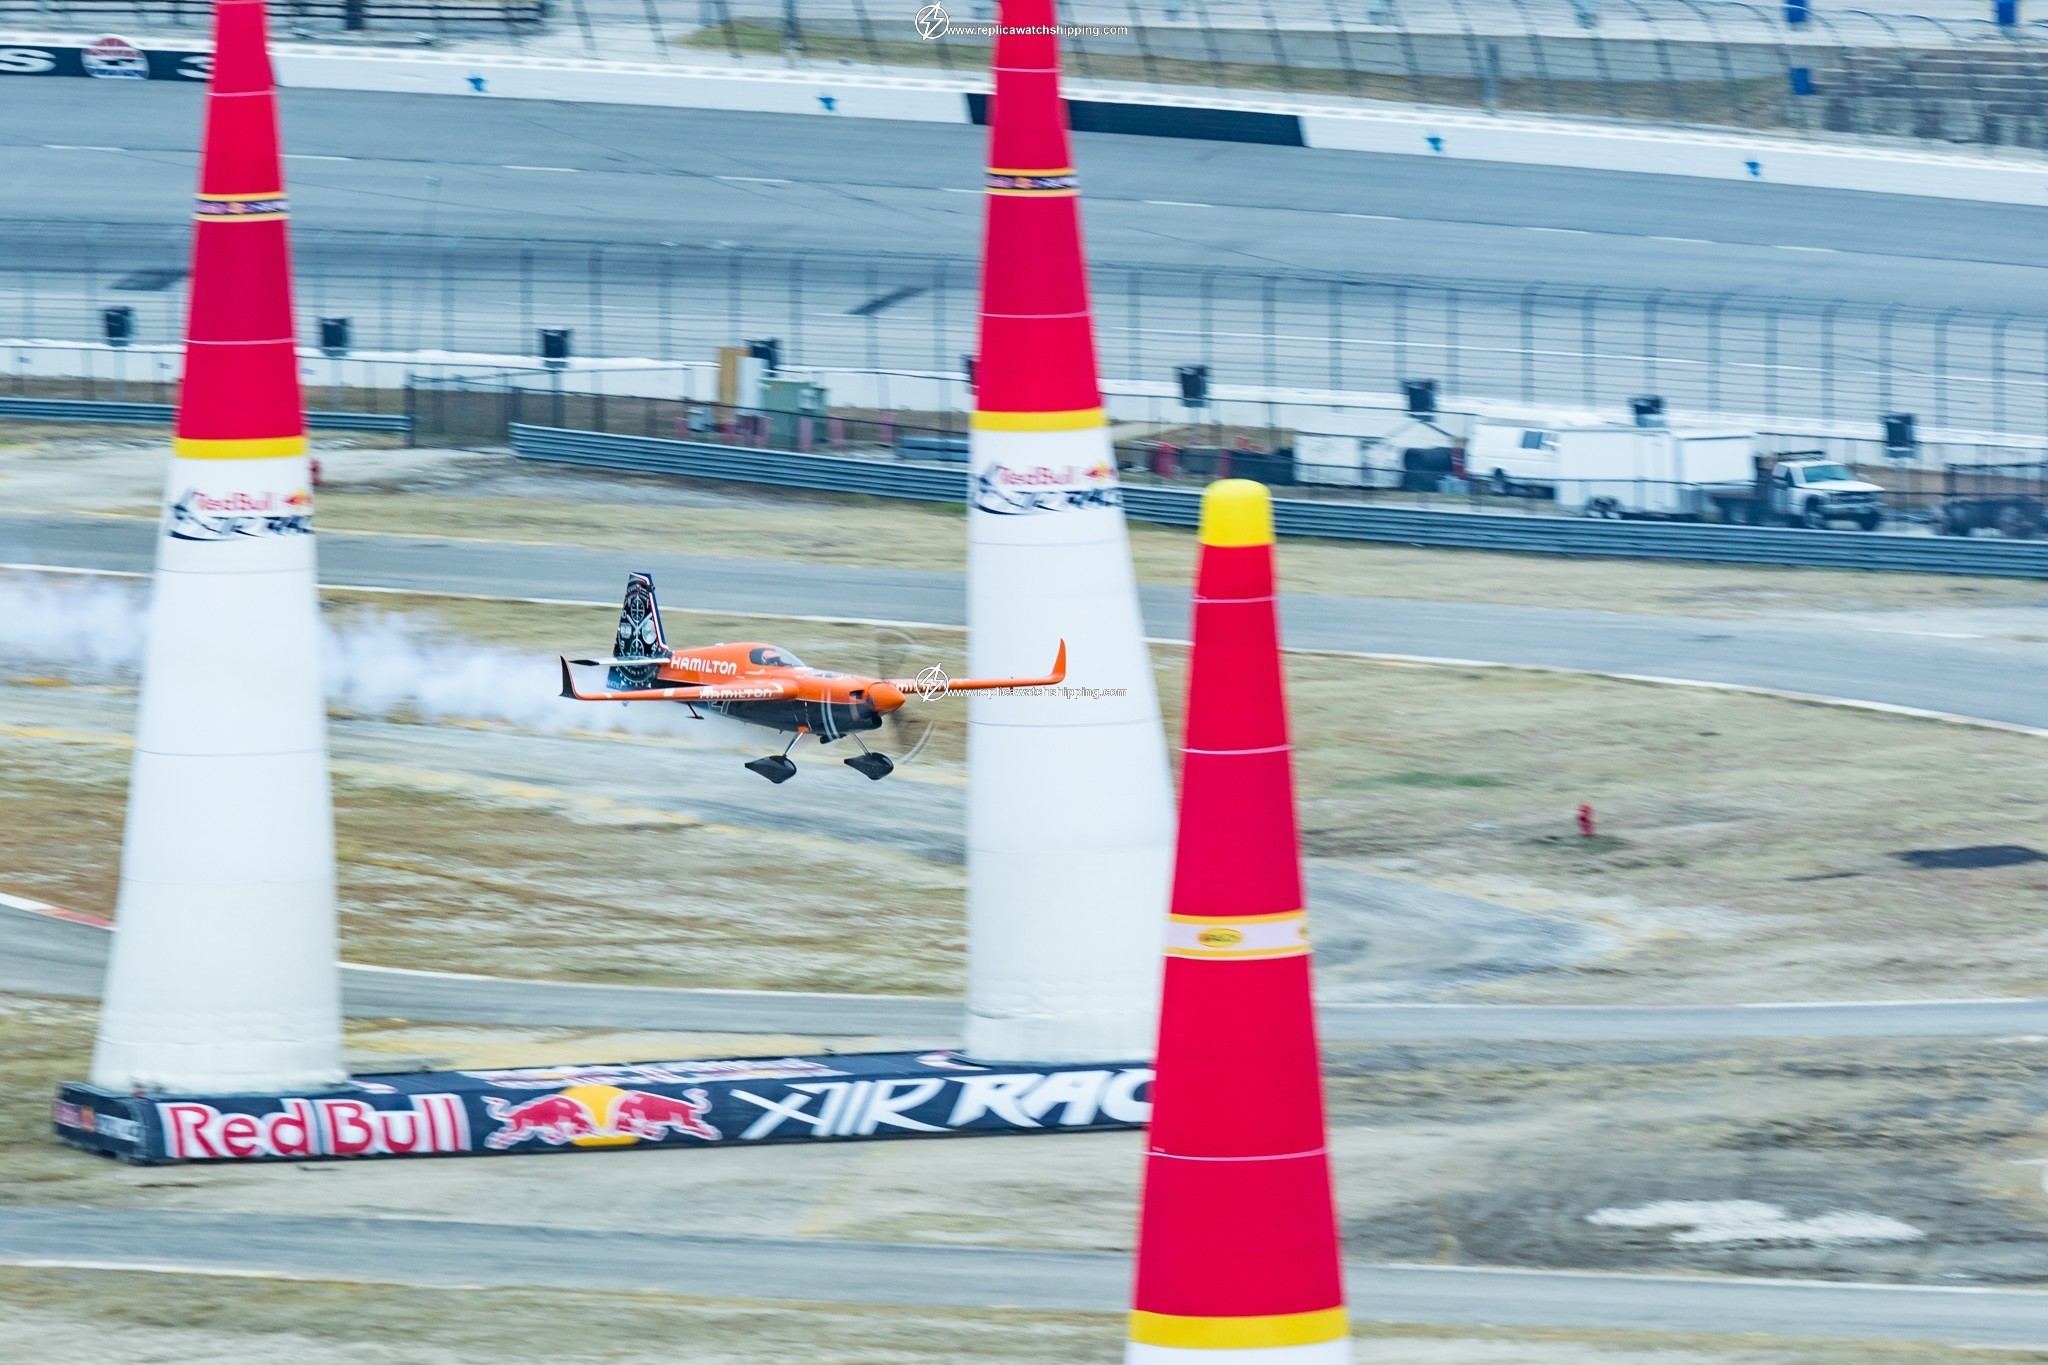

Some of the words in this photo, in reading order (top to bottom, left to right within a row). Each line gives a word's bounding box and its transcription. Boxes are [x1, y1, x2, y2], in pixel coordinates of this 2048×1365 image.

[670, 656, 738, 676] HAMILTON
[699, 687, 773, 699] HAMILTON
[157, 1097, 320, 1158] Red
[312, 1093, 472, 1154] Bull
[944, 1068, 1154, 1128] RAC
